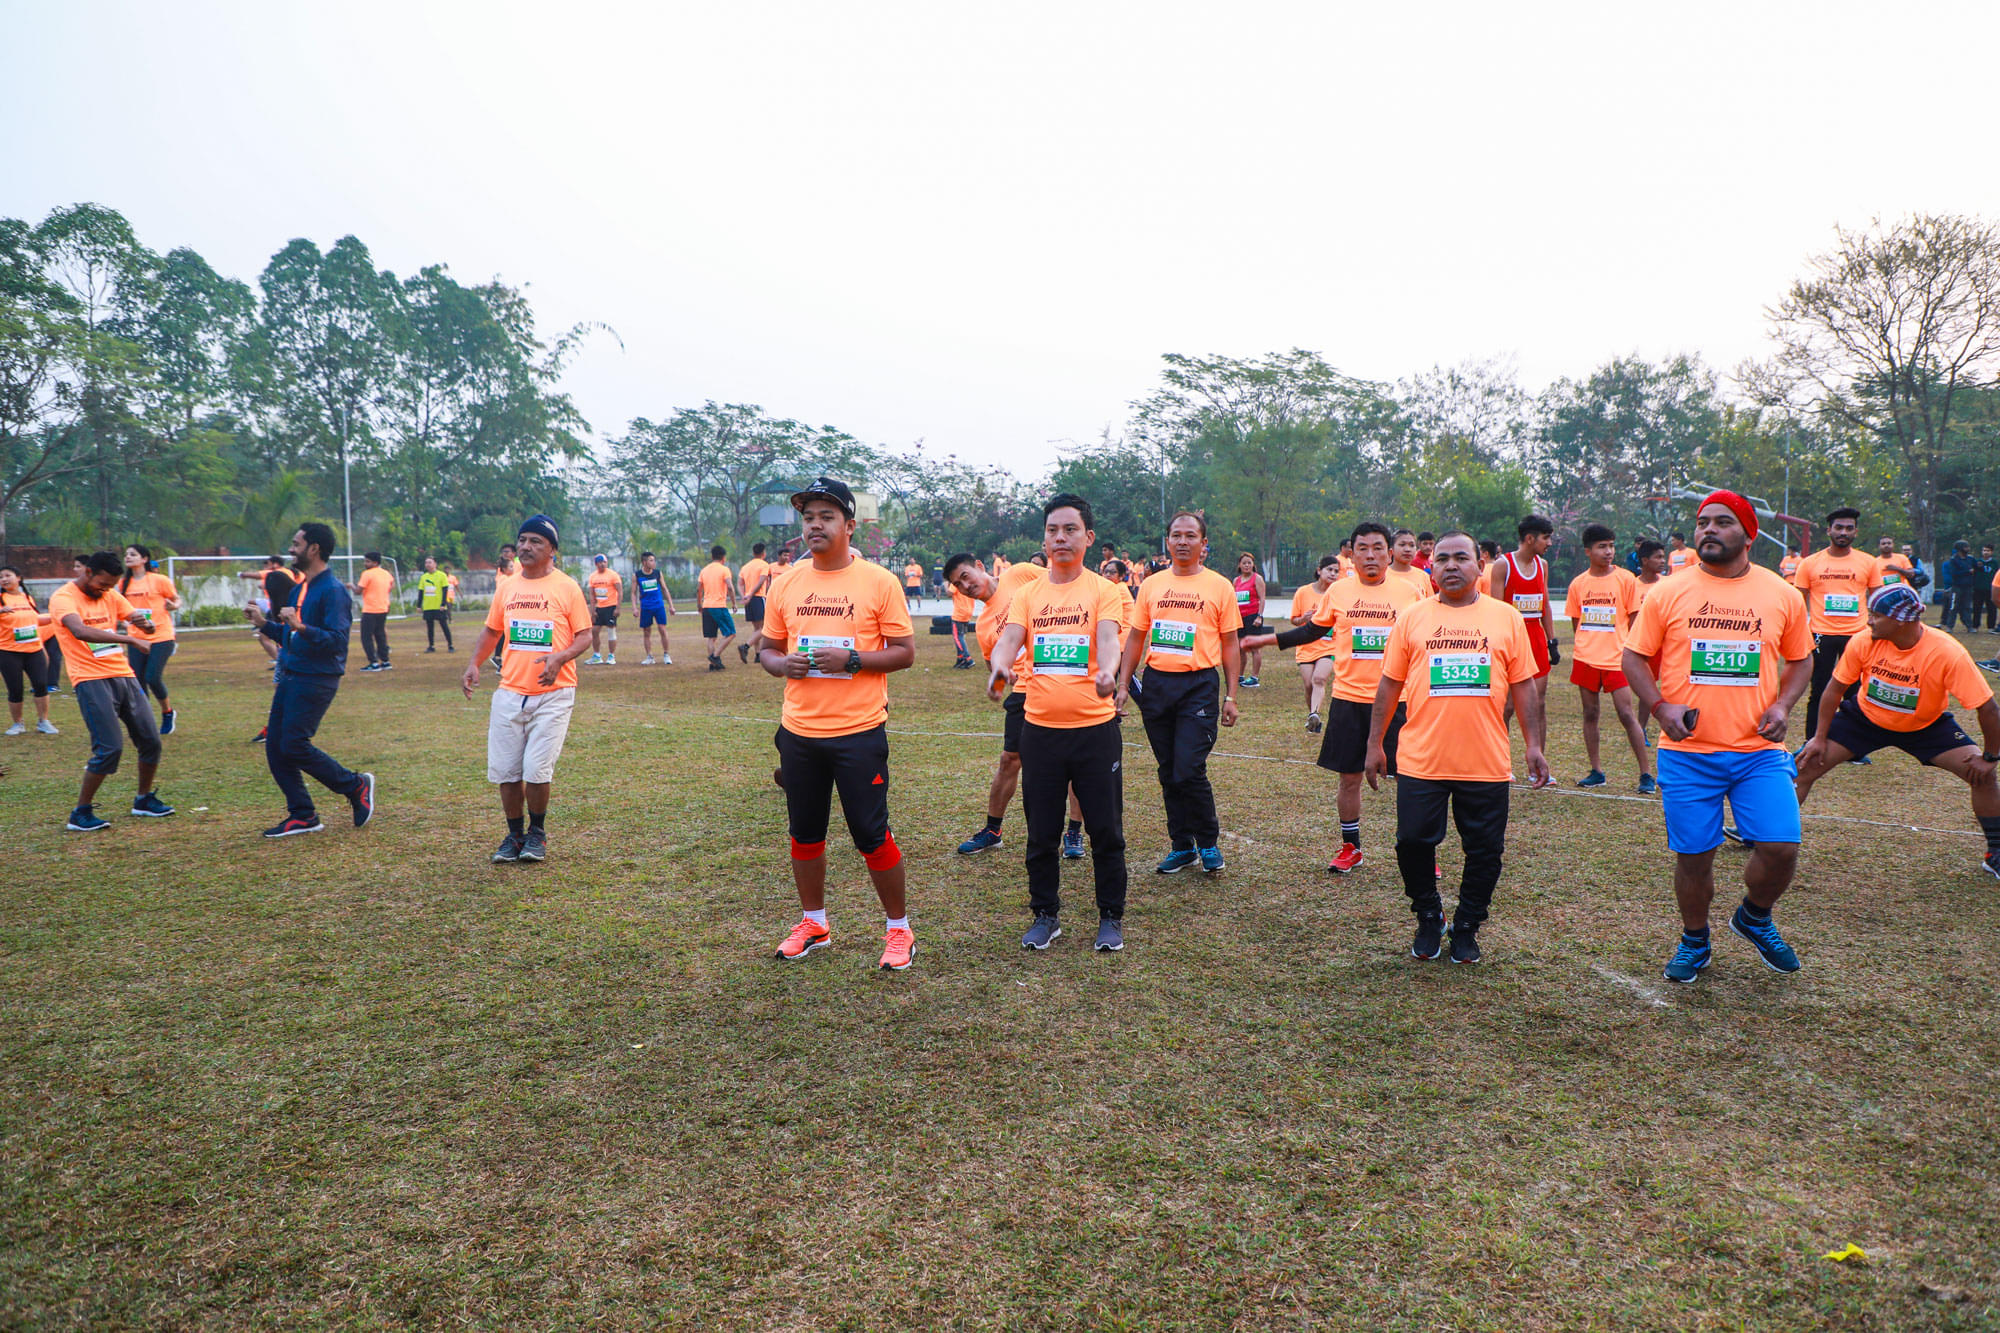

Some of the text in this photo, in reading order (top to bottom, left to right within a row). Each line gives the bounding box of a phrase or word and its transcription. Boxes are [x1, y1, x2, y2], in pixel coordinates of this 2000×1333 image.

[505, 601, 541, 611] YOUTHRUN
[796, 606, 844, 617] YOUTHRUN
[1157, 600, 1197, 610] YOUTHRUN
[1346, 610, 1389, 619] YOUTHRUN
[1032, 614, 1080, 629] YOUTHRUN
[1688, 618, 1751, 631] YOUTHRUN
[517, 628, 544, 639] 5490
[1158, 629, 1187, 642] 5680
[1425, 640, 1479, 650] YOUTHRUN
[1043, 645, 1078, 659] 5122
[1704, 652, 1748, 667] 5410
[1442, 666, 1480, 679] 5343
[1876, 688, 1906, 703] 5381
